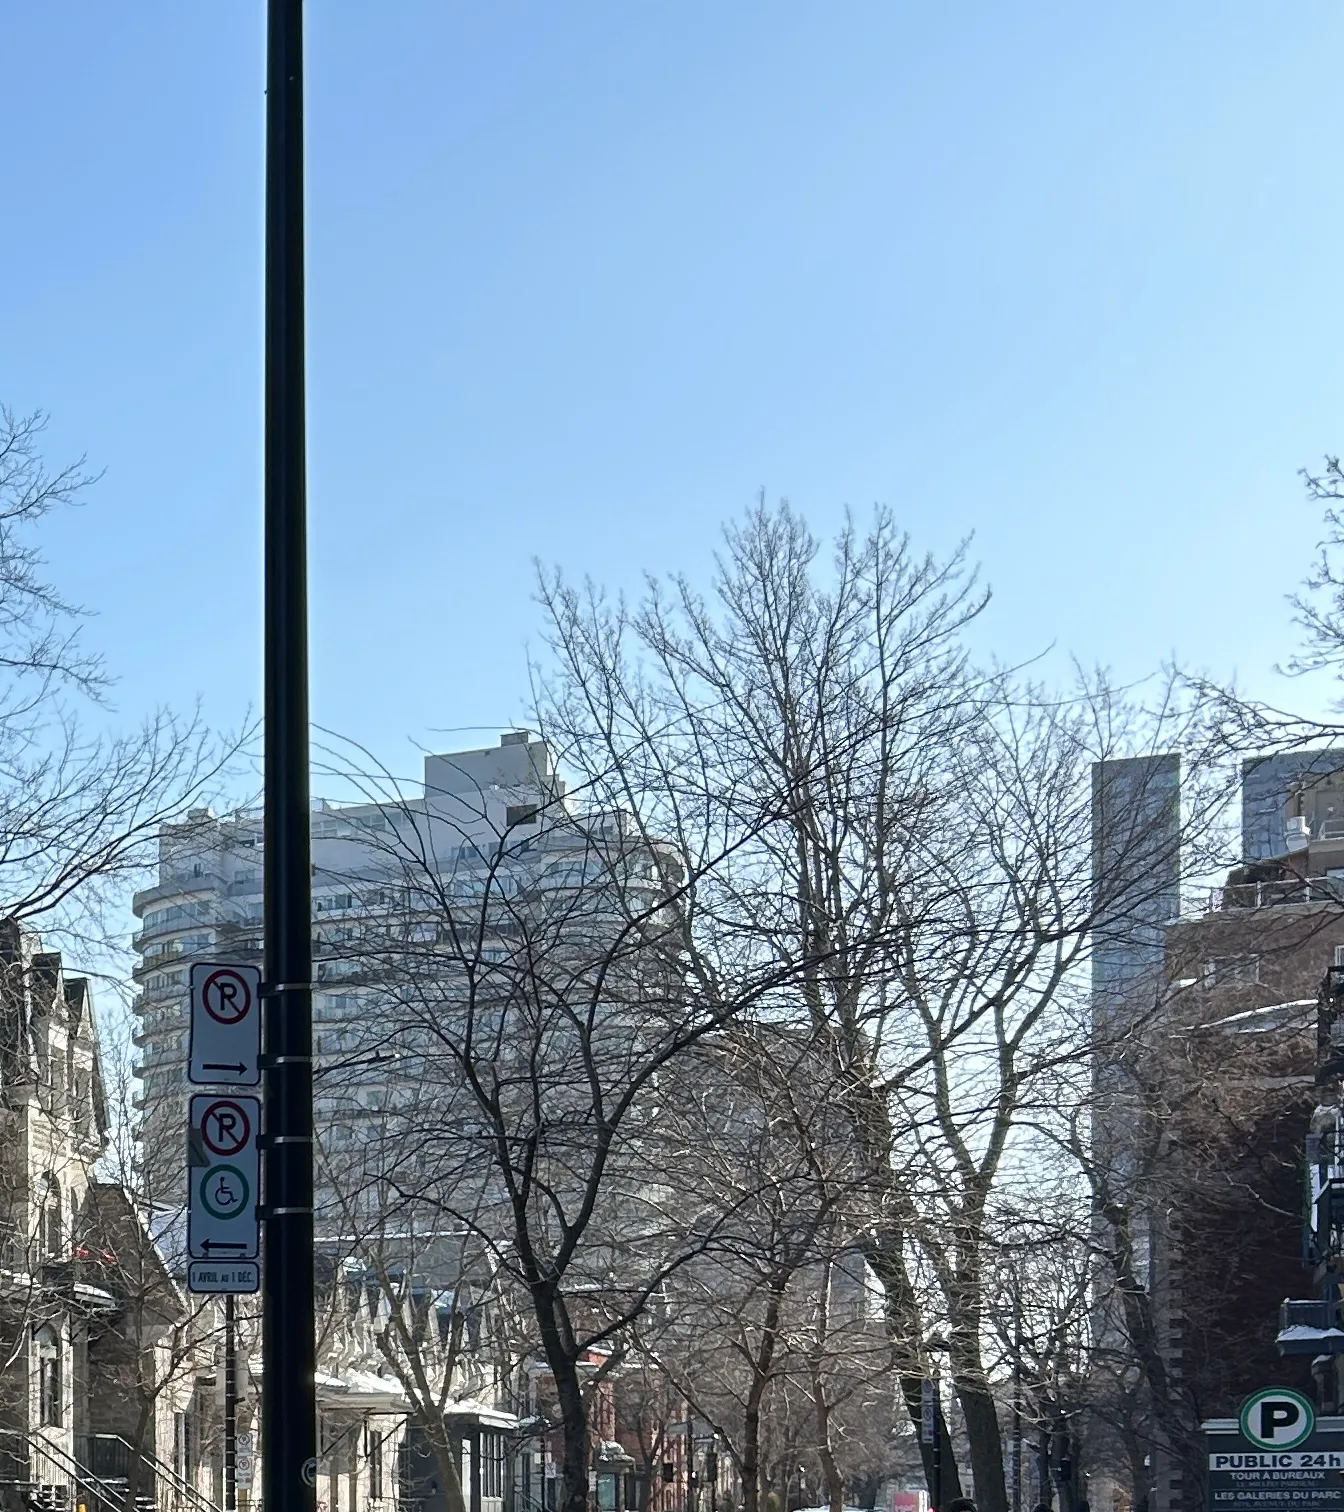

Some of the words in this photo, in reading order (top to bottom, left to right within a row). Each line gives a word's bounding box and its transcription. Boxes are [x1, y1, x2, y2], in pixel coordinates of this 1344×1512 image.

[219, 982, 238, 1011] P
[217, 1113, 237, 1143] P
[1260, 1401, 1300, 1439] P
[1215, 1454, 1293, 1469] PUBLIC
[1230, 1471, 1261, 1481] TOUR
[1272, 1471, 1326, 1480] BUREAUX
[1214, 1492, 1235, 1501] LES
[1237, 1491, 1291, 1500] GALERIES
[1292, 1490, 1309, 1500] DU
[1311, 1490, 1342, 1499] PARC
